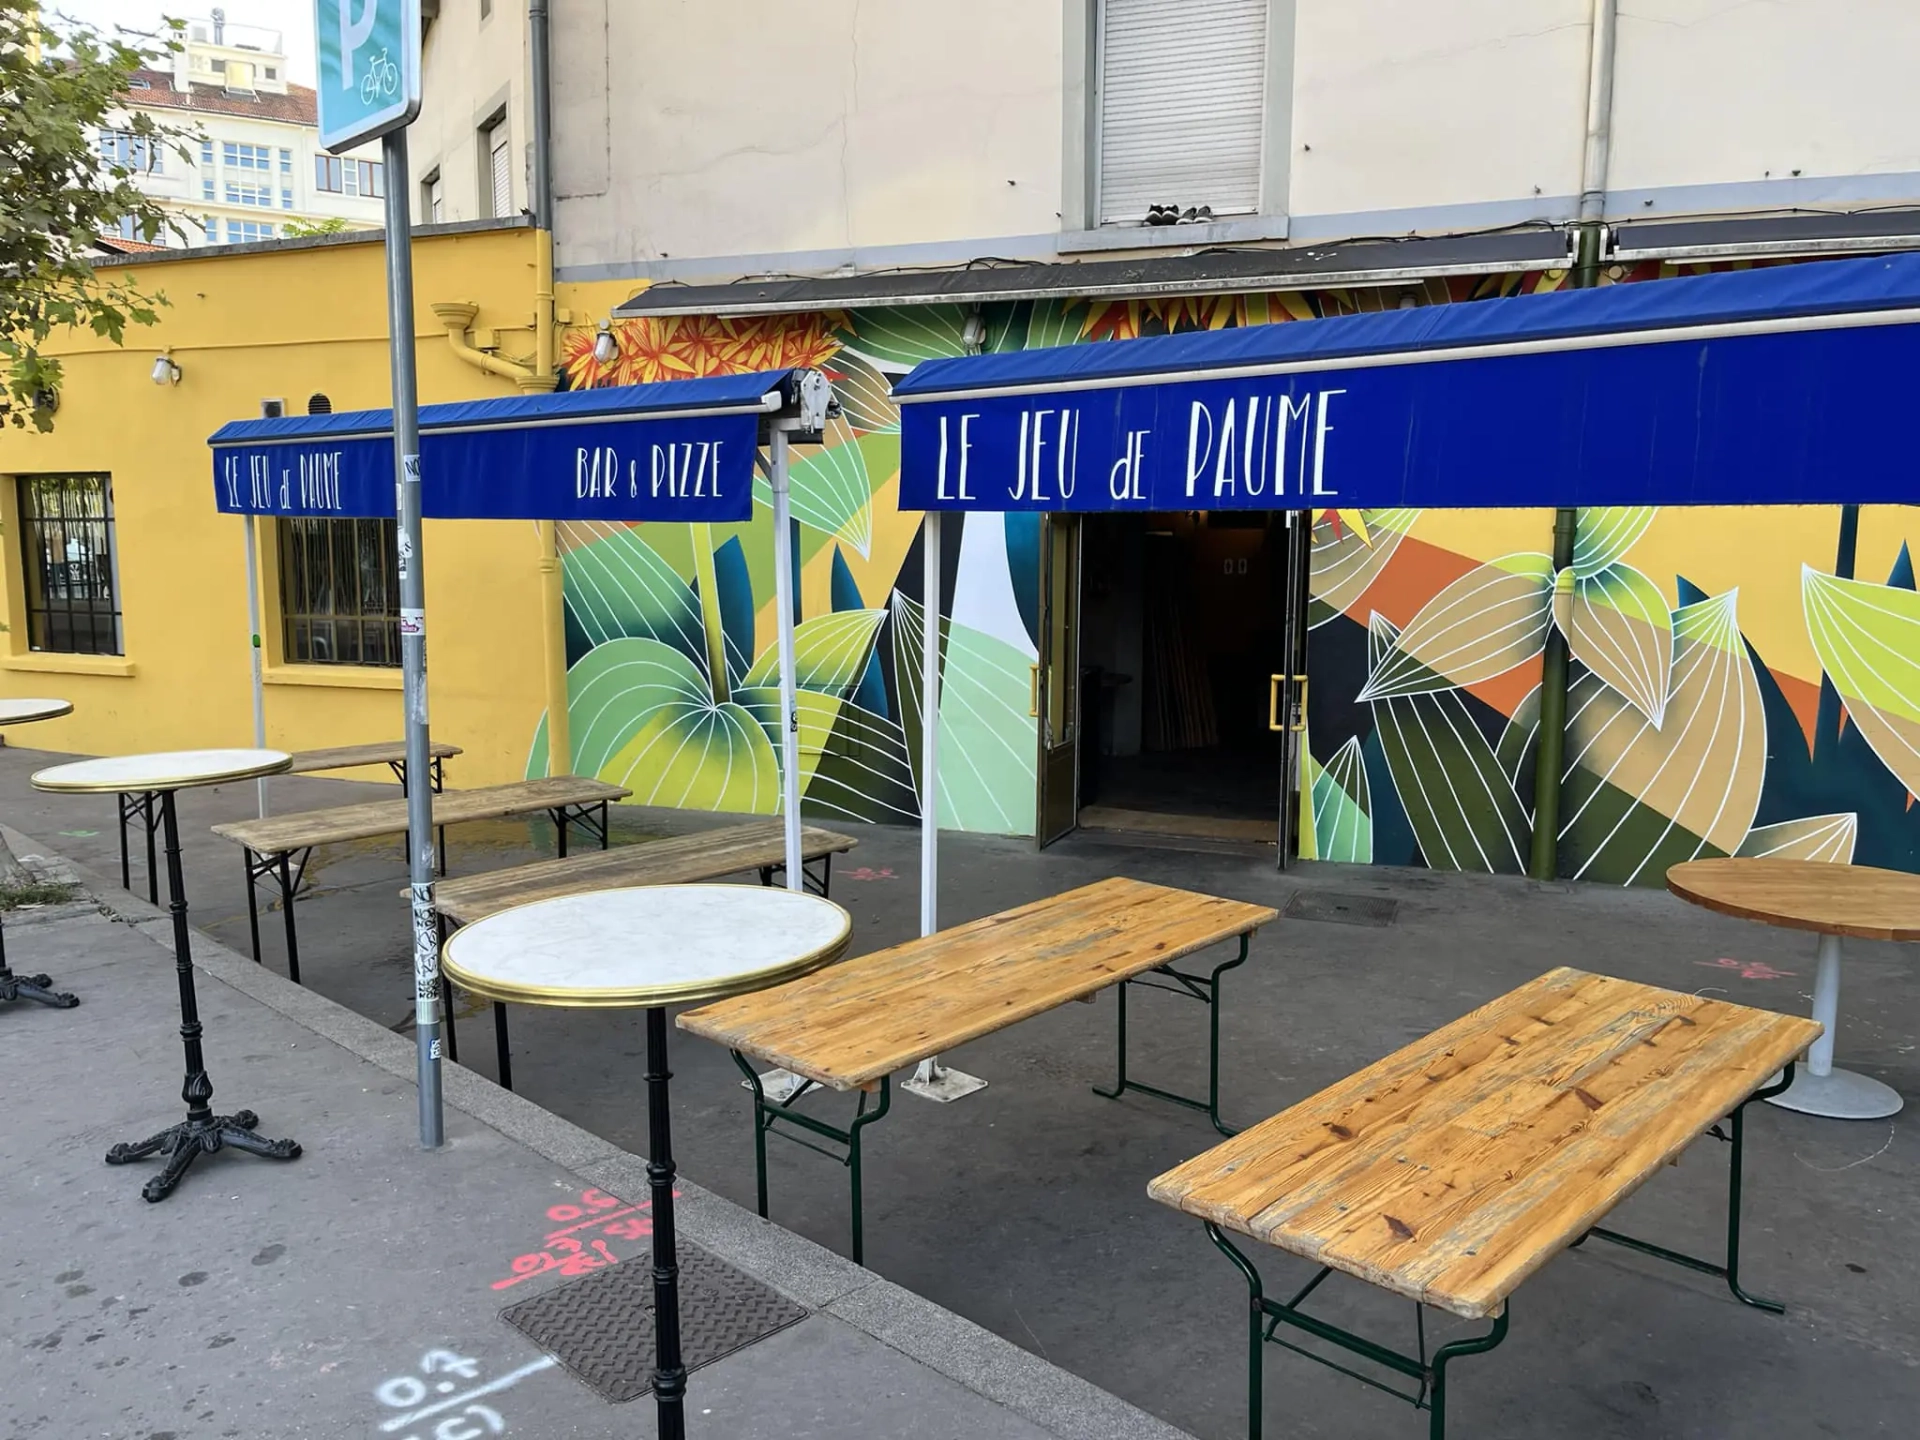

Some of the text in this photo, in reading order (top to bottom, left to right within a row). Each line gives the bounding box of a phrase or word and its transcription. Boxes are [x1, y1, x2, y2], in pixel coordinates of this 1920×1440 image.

[340, 0, 377, 91] P
[225, 456, 242, 508] LE
[249, 455, 272, 509] JEU
[300, 451, 343, 510] PAUME
[577, 447, 618, 499] BAR
[652, 441, 724, 498] PIZZE
[935, 413, 980, 500] LE
[1008, 409, 1080, 501] JEU
[1186, 389, 1347, 497] PAUME
